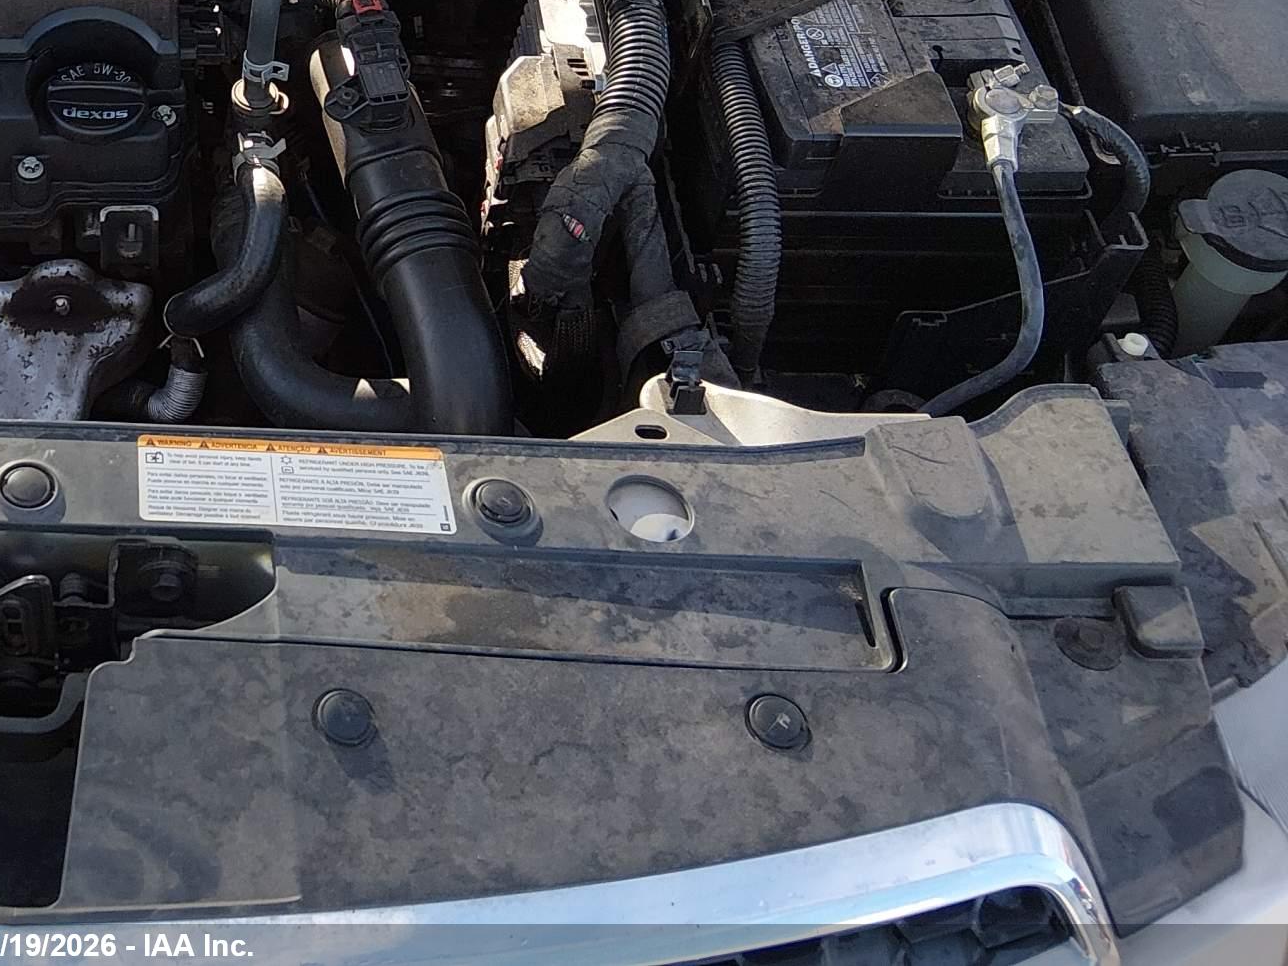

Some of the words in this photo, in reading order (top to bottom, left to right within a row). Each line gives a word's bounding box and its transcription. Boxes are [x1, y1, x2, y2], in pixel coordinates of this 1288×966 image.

[61, 65, 87, 82] SAE
[93, 62, 132, 83] 5W-30
[62, 106, 129, 120] dexos
